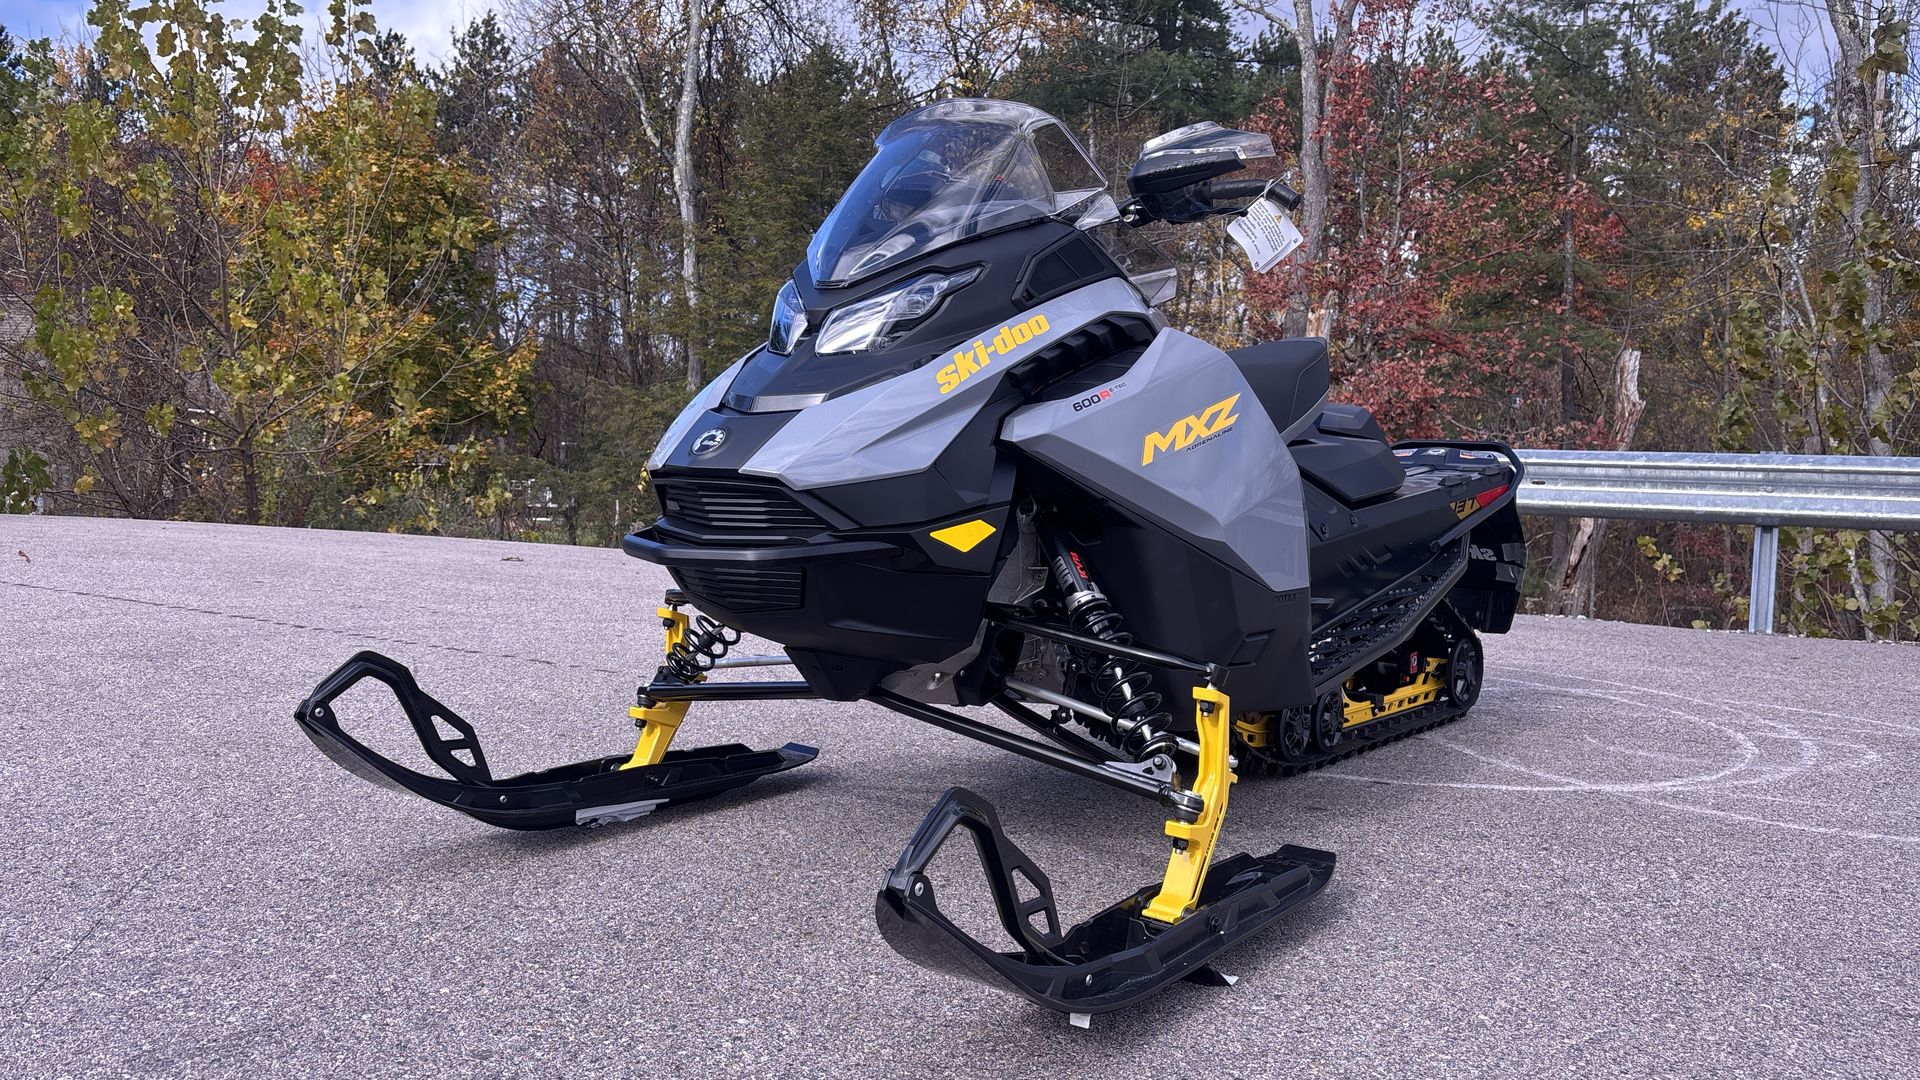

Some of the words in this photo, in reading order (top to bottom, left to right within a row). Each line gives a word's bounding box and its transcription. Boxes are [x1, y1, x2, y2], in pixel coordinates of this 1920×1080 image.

[935, 314, 1051, 395] ski-doo
[1073, 389, 1111, 412] 600R
[1142, 392, 1241, 466] MXZ
[1186, 426, 1234, 453] ADRENALINE
